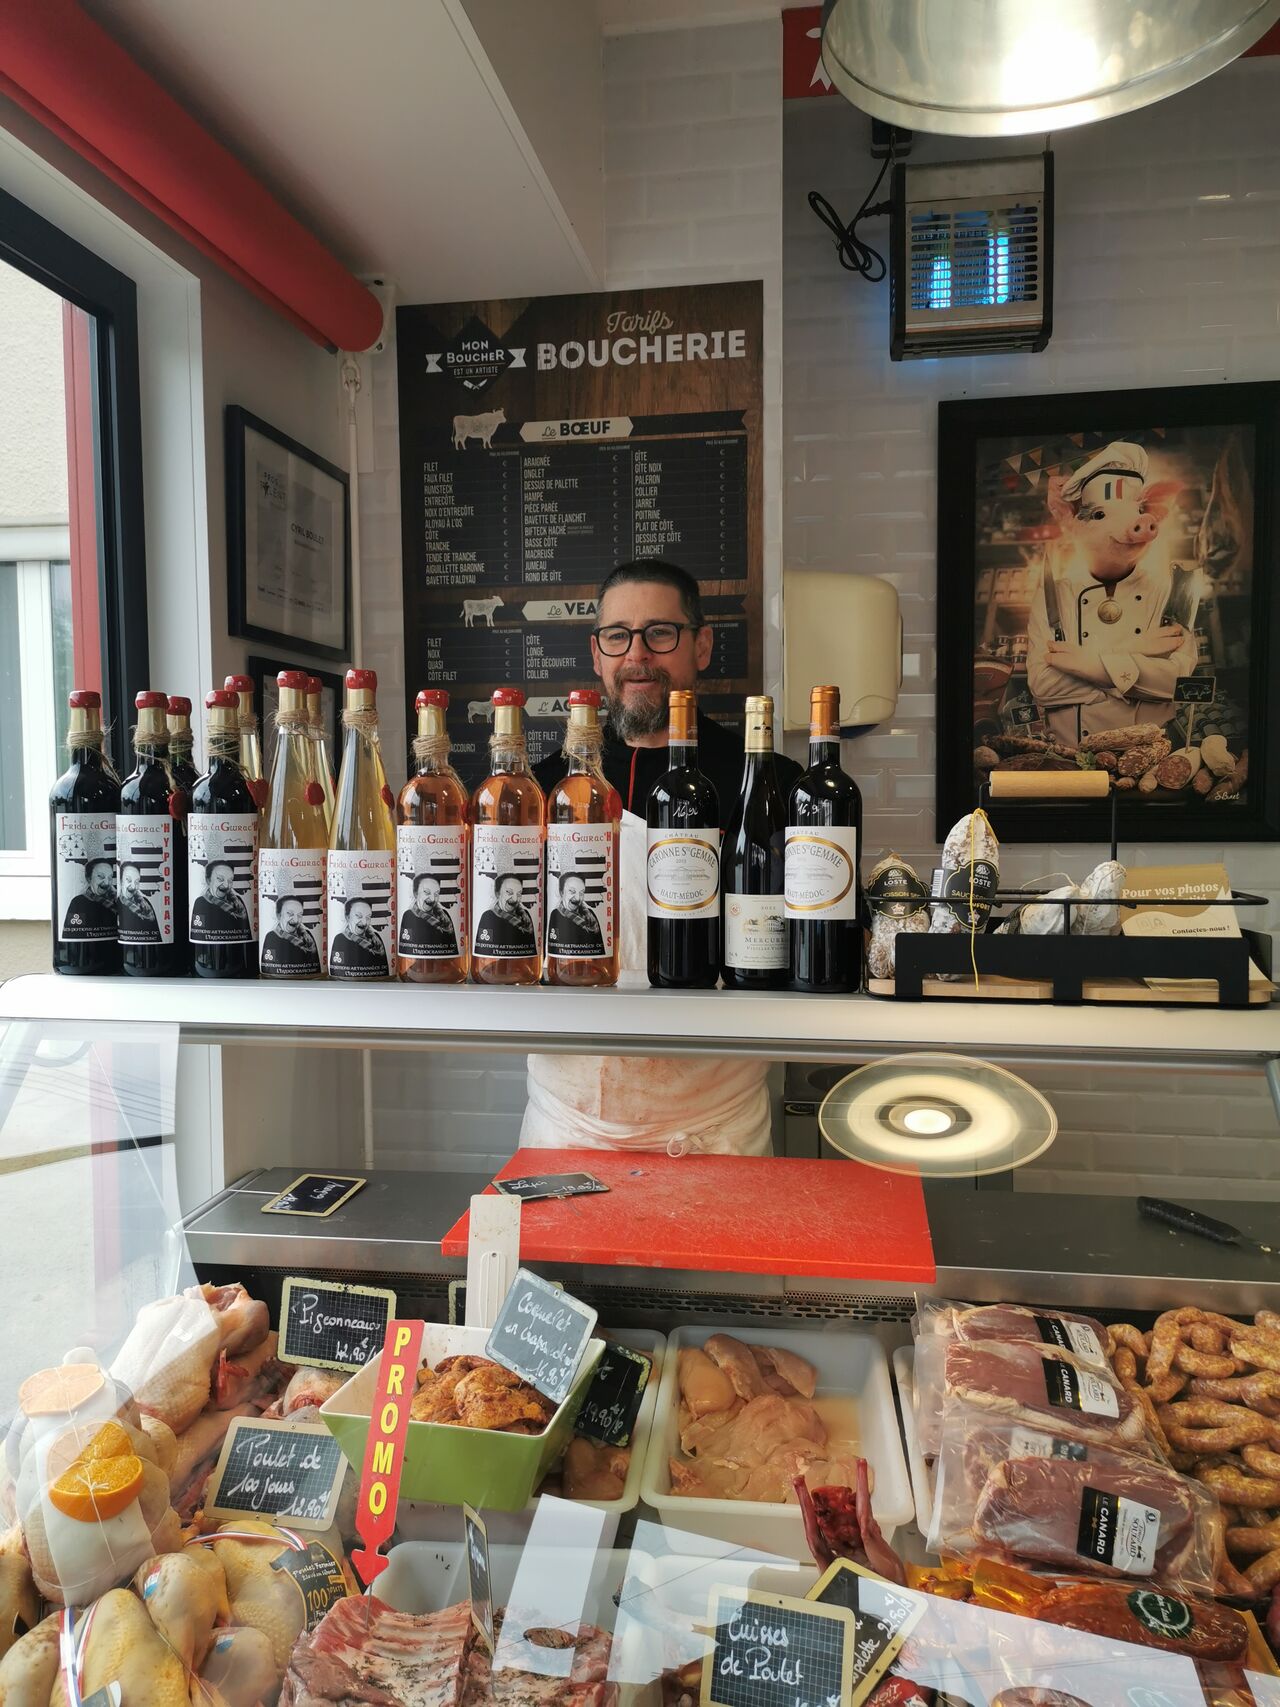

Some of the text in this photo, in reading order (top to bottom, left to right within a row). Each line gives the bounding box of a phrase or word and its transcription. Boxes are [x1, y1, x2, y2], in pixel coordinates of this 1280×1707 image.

[606, 310, 674, 335] Tarifs
[462, 340, 489, 351] MON
[537, 329, 746, 371] BOUCHERIE
[446, 349, 504, 363] BOUCHER
[453, 366, 498, 376] EST UN ARTISTE
[541, 421, 611, 438] Le BŒUF
[524, 455, 551, 466] ARAIGNÉE
[423, 462, 438, 472] FILET
[648, 463, 662, 473] NOIX
[424, 472, 453, 483] FAUX FILET
[524, 469, 545, 479] ONGLET
[635, 474, 661, 485] PALERON
[424, 484, 454, 494] RUMSTECK
[524, 478, 579, 490] DESSUS DE PALETTE
[524, 491, 544, 502] HAMPE
[635, 486, 658, 497] COLLIER
[424, 495, 455, 506] ENTRECÔTE
[635, 498, 656, 509] JARRET
[425, 508, 437, 518] NOIX
[524, 512, 586, 525] BAVETTE DE FLANCHET
[635, 509, 661, 520] POITRINE
[425, 519, 446, 529] ALOYAU
[635, 519, 674, 532] PLAT DE CÔTE
[425, 529, 439, 540] CÔTE
[525, 526, 547, 536] BIFTECK
[525, 536, 558, 548] BASSE CÔTE
[635, 531, 681, 544] DESSUS DE CÔTE
[425, 541, 450, 551] TRANCHE
[635, 544, 664, 555] FLANCHET
[425, 551, 477, 563] TENDE DE TRANCHE
[525, 548, 554, 559] MACREUSE
[426, 562, 485, 574] AIGUILLETTE BARONNE
[525, 560, 547, 570] JUMEAU
[426, 574, 476, 585] BAVETTE D'ALOYAU
[525, 572, 540, 582] ROND
[541, 572, 549, 581] DE
[547, 602, 596, 616] Le VEA
[427, 637, 442, 648] FILET
[526, 634, 540, 645] CÔTE
[427, 649, 440, 659] NOIX
[526, 647, 544, 657] LONGE
[427, 660, 444, 670] QUASI
[527, 656, 577, 668] CÔTE DÉCOUVERTE
[428, 670, 457, 681] CÔTE FILET
[527, 669, 549, 679] COLLIER
[528, 730, 557, 741] CÔTE FILET
[450, 743, 476, 753] ACCOURCI
[528, 741, 542, 752] CÔTE
[649, 847, 680, 868] CARONNE
[690, 847, 715, 868] GEMME
[810, 845, 844, 868] GEMME
[969, 877, 992, 888] OSTE
[1122, 883, 1219, 898] Pour vos photos
[508, 1180, 548, 1190] Lapin
[518, 1291, 572, 1333] Coquelet
[504, 1322, 518, 1335] en
[1060, 1368, 1073, 1403] CANARD
[368, 1326, 412, 1516] PROMO
[236, 1433, 321, 1470] Poulet de
[227, 1472, 296, 1510] 100 jours
[1096, 1496, 1109, 1555] LE CANARD
[292, 1560, 336, 1578] Poulet Fermier
[307, 1587, 328, 1612] 100
[728, 1607, 790, 1647] Cuisses
[720, 1646, 805, 1686] de Poulet
